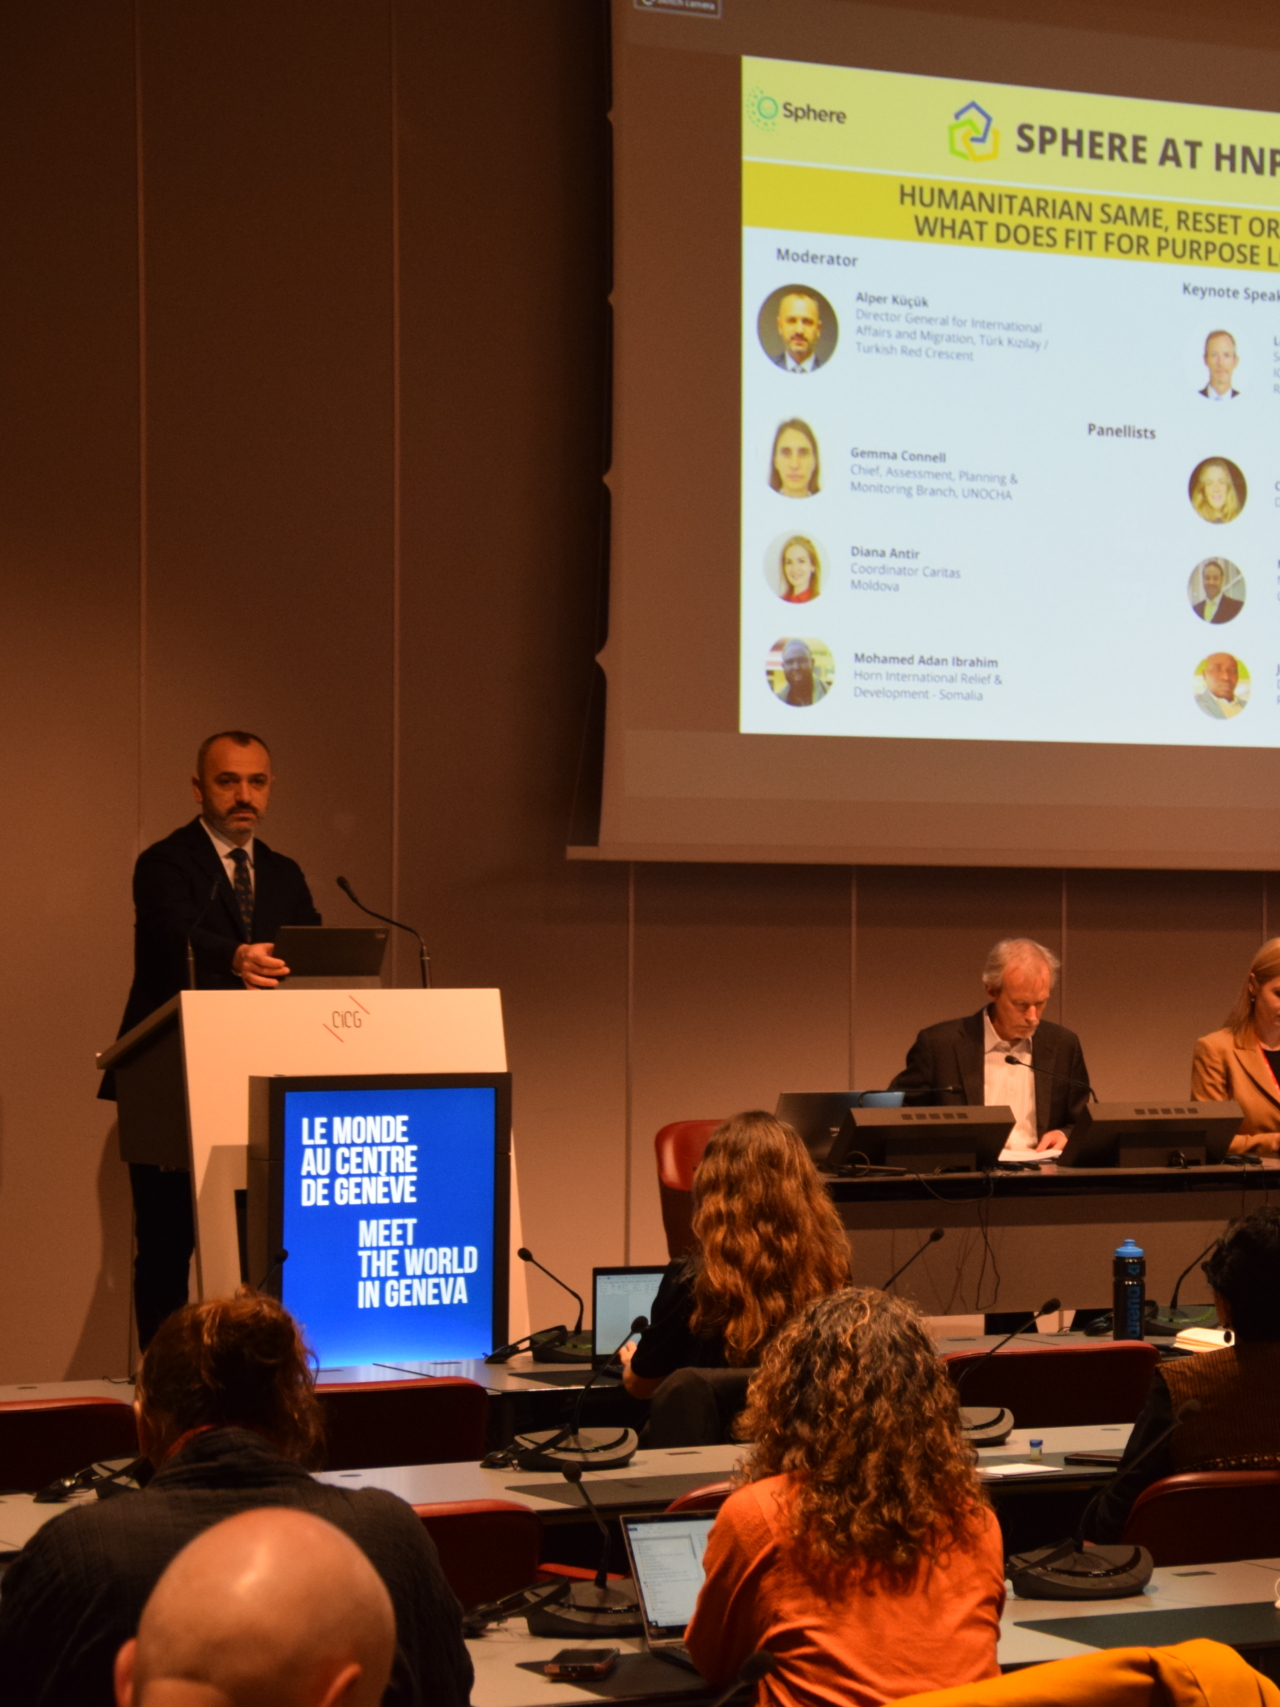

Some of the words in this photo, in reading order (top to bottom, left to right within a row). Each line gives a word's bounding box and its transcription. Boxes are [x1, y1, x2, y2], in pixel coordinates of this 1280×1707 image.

[782, 101, 847, 126] Sphere
[1016, 123, 1147, 164] SPHERE
[1159, 138, 1203, 169] AT
[900, 184, 1093, 223] HUMANITARIAN
[1100, 202, 1170, 232] SAME,
[1177, 210, 1242, 236] RESET
[1248, 216, 1280, 240] OR
[914, 214, 988, 242] WHAT
[995, 223, 1057, 248] DOES
[1065, 228, 1097, 251] FIT
[1104, 232, 1150, 256] FOR
[1157, 237, 1260, 265] PURPOSE
[776, 248, 858, 267] Moderator
[856, 292, 888, 305] Alper
[892, 295, 929, 309] Küçük
[1182, 282, 1239, 301] Keynote
[856, 309, 901, 321] Director
[905, 312, 949, 326] General
[952, 316, 967, 327] for
[971, 318, 1042, 333] International
[856, 326, 892, 338] Affairs
[895, 330, 917, 340] and
[921, 331, 976, 345] Migration,
[980, 335, 1004, 347] Türk
[856, 342, 897, 355] Turkish
[901, 346, 922, 357] Red
[925, 348, 973, 361] Crescent
[1088, 423, 1156, 439] Panellists
[851, 448, 897, 461] Gemma
[901, 449, 946, 464] Connell
[851, 464, 883, 478] Chief,
[886, 466, 955, 483] Assessment,
[959, 471, 1006, 486] Planning
[1009, 474, 1018, 485] &
[851, 481, 913, 498] Monitoring
[916, 485, 959, 499] Branch,
[962, 488, 1012, 501] UNOCHA
[851, 546, 886, 559] Diana
[889, 548, 920, 560] Antir
[851, 563, 919, 578] Coordinator
[922, 566, 961, 579] Caritas
[851, 579, 900, 592] Moldova
[854, 652, 915, 666] Mohamed
[918, 654, 948, 667] Adan
[952, 656, 998, 669] Ibrahim
[854, 670, 882, 682] Horn
[886, 671, 958, 684] International
[961, 672, 991, 685] Relief
[994, 674, 1002, 685] &
[854, 687, 929, 702] Development
[939, 689, 983, 701] Somalia
[302, 1118, 327, 1145] LE
[333, 1115, 409, 1144] MONDE
[301, 1148, 331, 1176] AU
[336, 1145, 418, 1174] CENTRE
[301, 1178, 330, 1206] DE
[334, 1171, 417, 1205] GENÈVE
[359, 1218, 417, 1247] MEET
[358, 1250, 399, 1278] THE
[404, 1246, 477, 1276] WORLD
[358, 1280, 380, 1308] IN
[385, 1277, 468, 1307] GENEVA
[1127, 1286, 1140, 1338] arena
